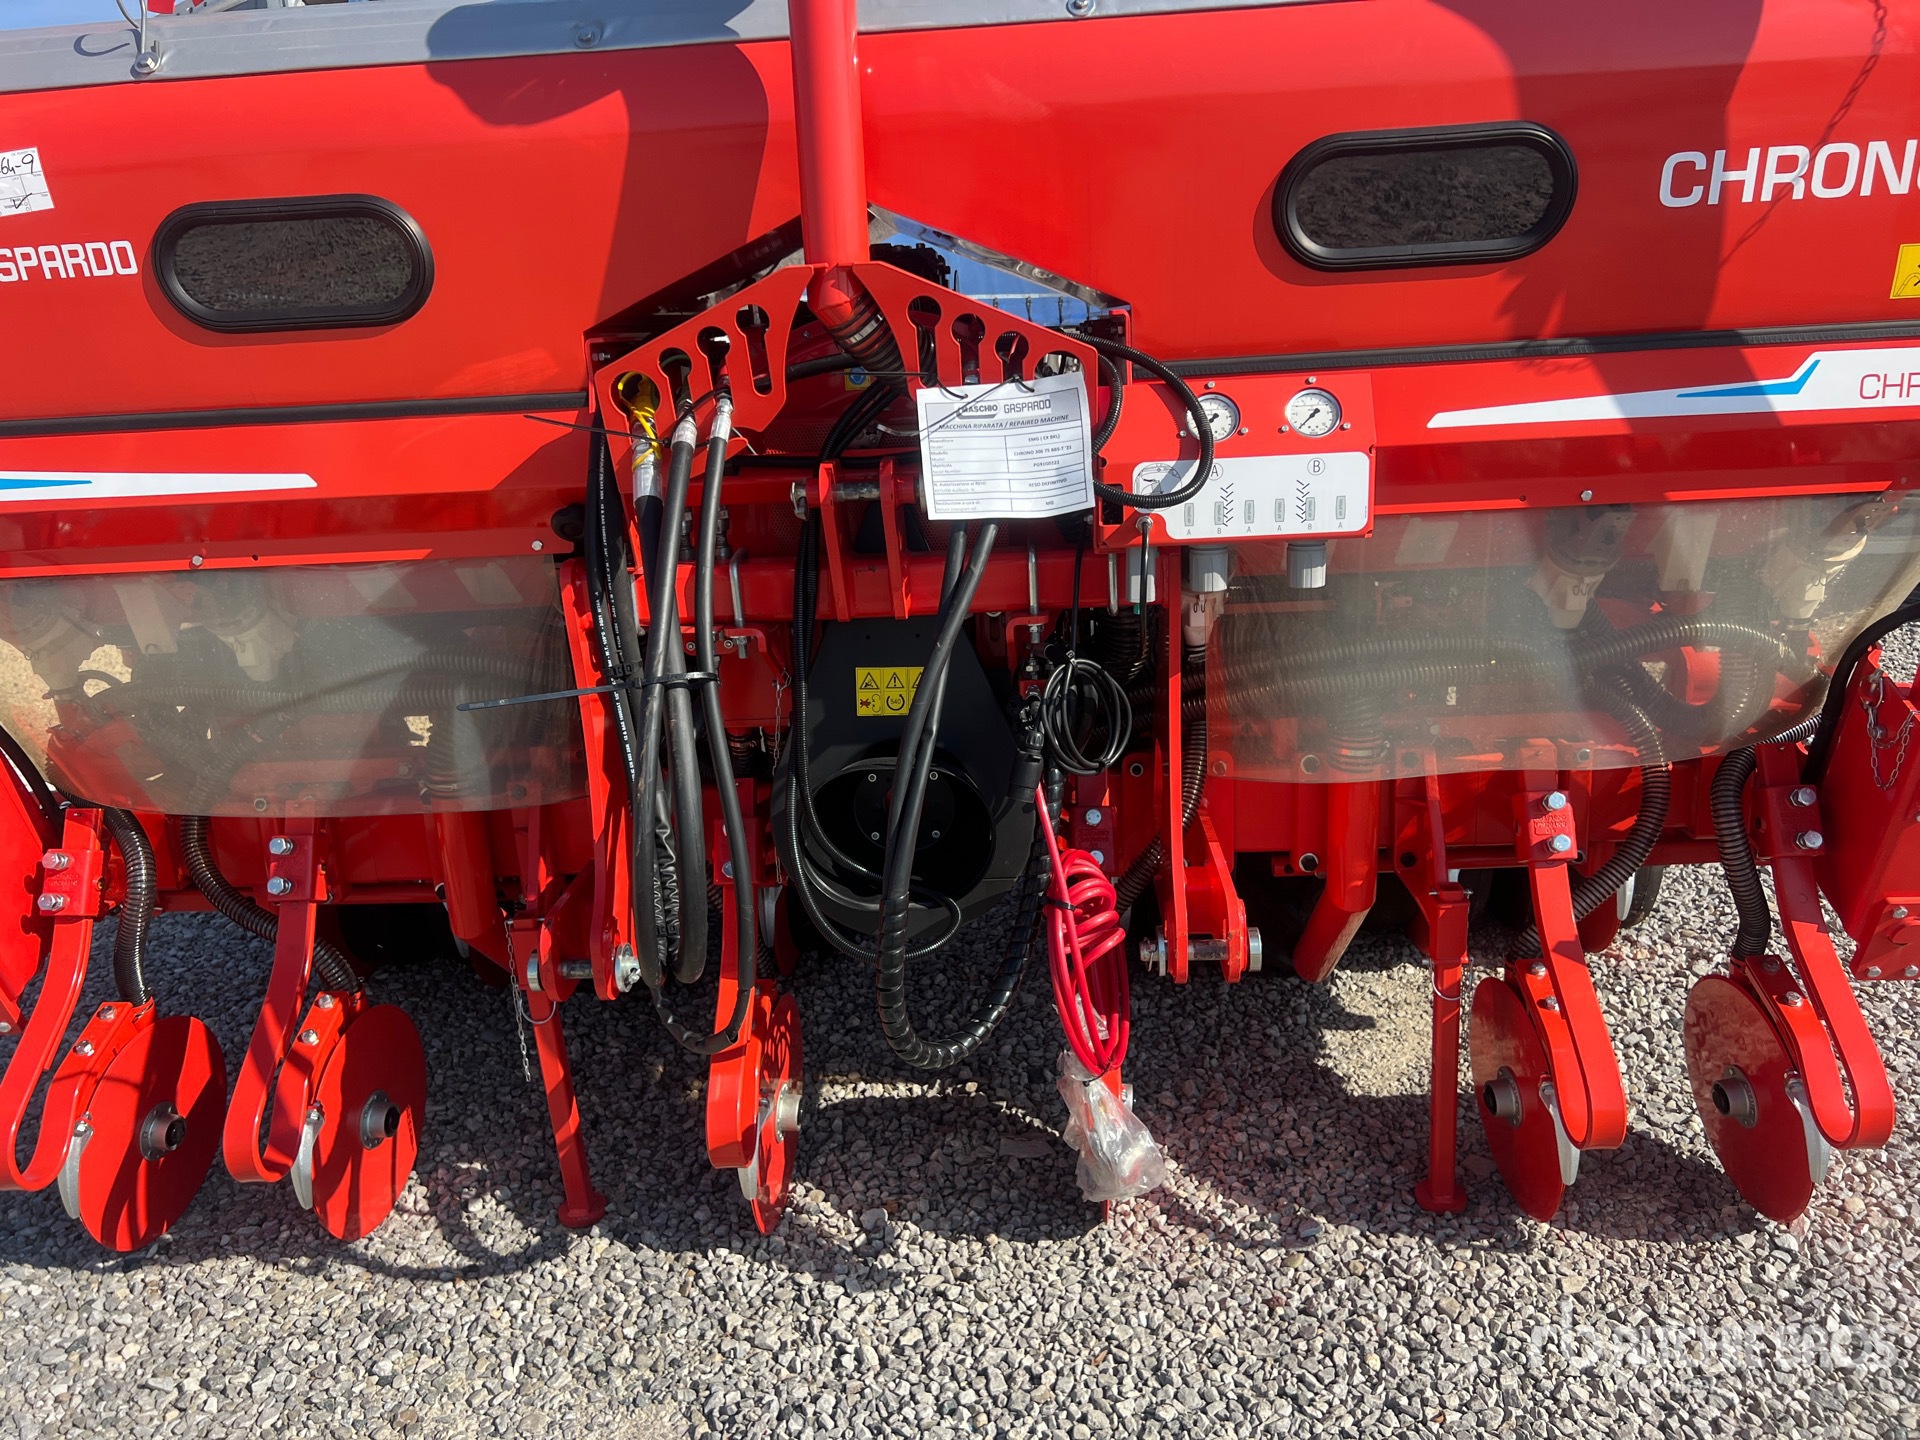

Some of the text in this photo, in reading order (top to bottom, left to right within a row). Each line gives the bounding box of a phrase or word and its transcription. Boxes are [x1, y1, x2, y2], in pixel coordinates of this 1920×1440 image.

[1659, 139, 1920, 208] CHRON
[0, 240, 138, 282] SPARDO
[1004, 399, 1052, 414] GASPARDO
[1010, 419, 1039, 427] REPAIRED
[1040, 414, 1069, 424] MACHINE
[1211, 465, 1218, 477] A
[1313, 460, 1320, 473] B
[1042, 478, 1067, 486] DEFINITIVO
